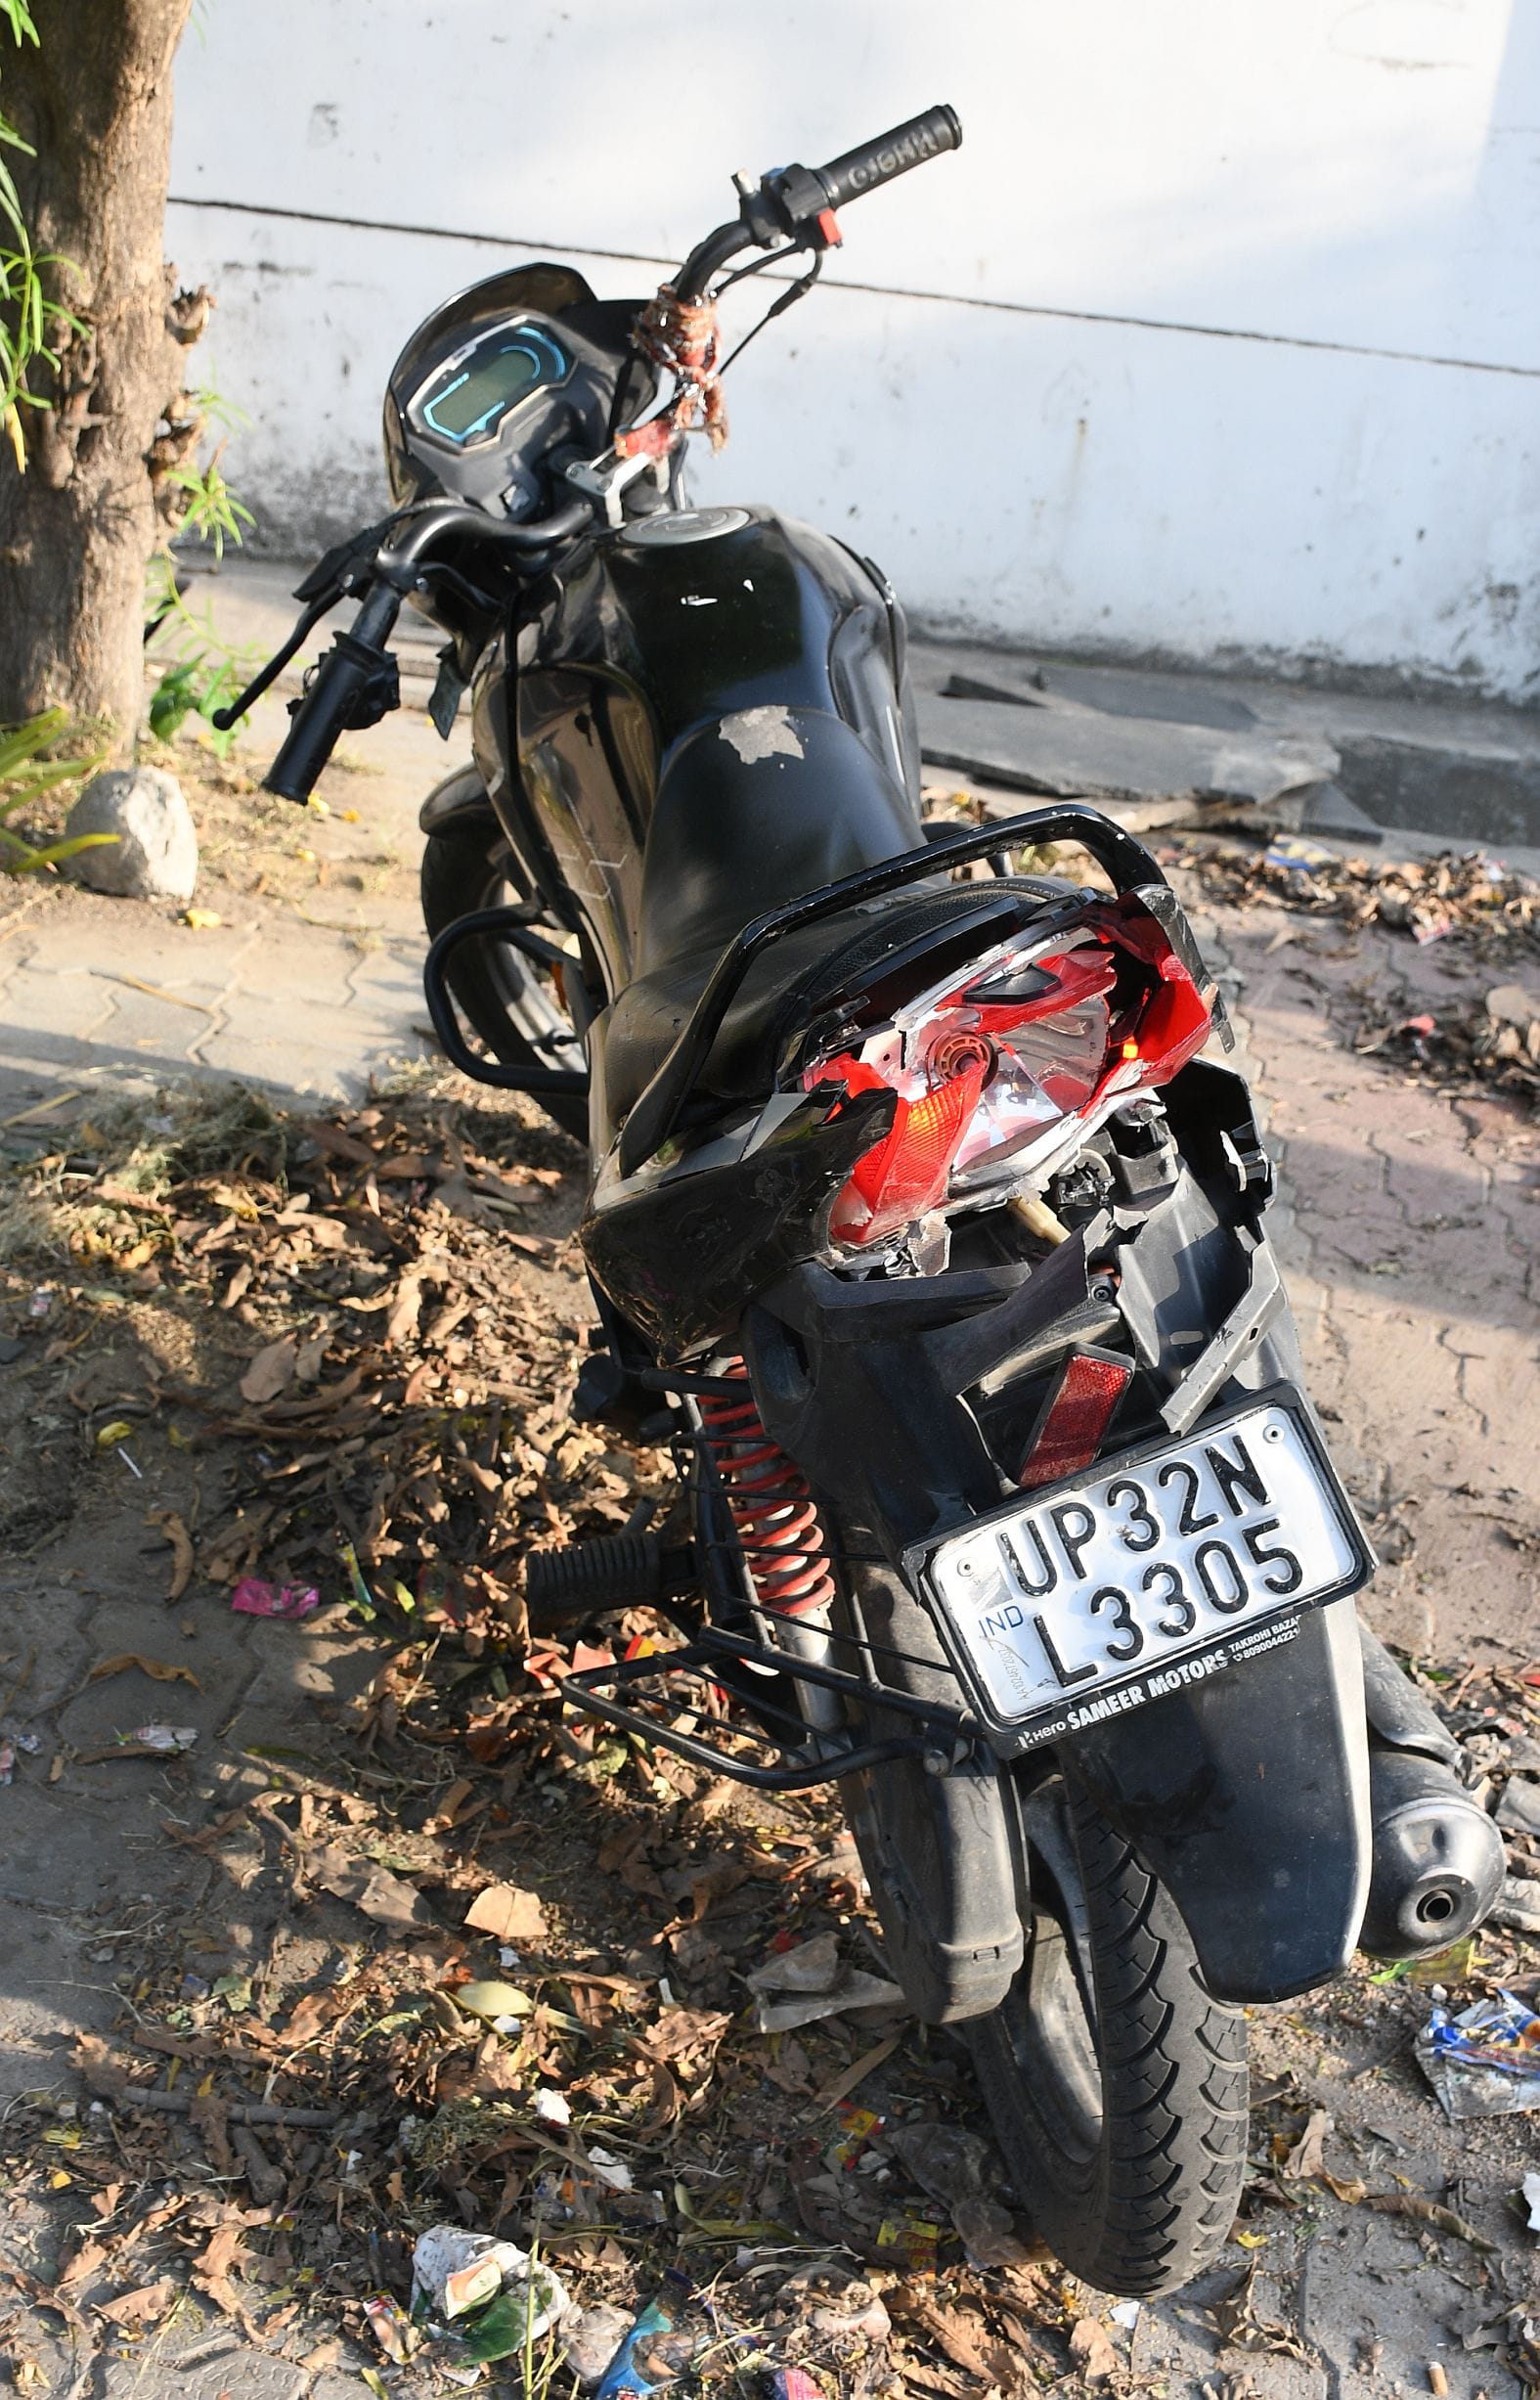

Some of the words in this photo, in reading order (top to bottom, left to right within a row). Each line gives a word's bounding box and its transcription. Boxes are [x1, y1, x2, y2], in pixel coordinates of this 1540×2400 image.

[979, 1605, 1024, 1637] IND
[1034, 1519, 1303, 1688] L3305
[1228, 1628, 1271, 1653] TAKROHI
[1067, 1686, 1147, 1730] SAMEER
[1147, 1649, 1229, 1698] MOTORS
